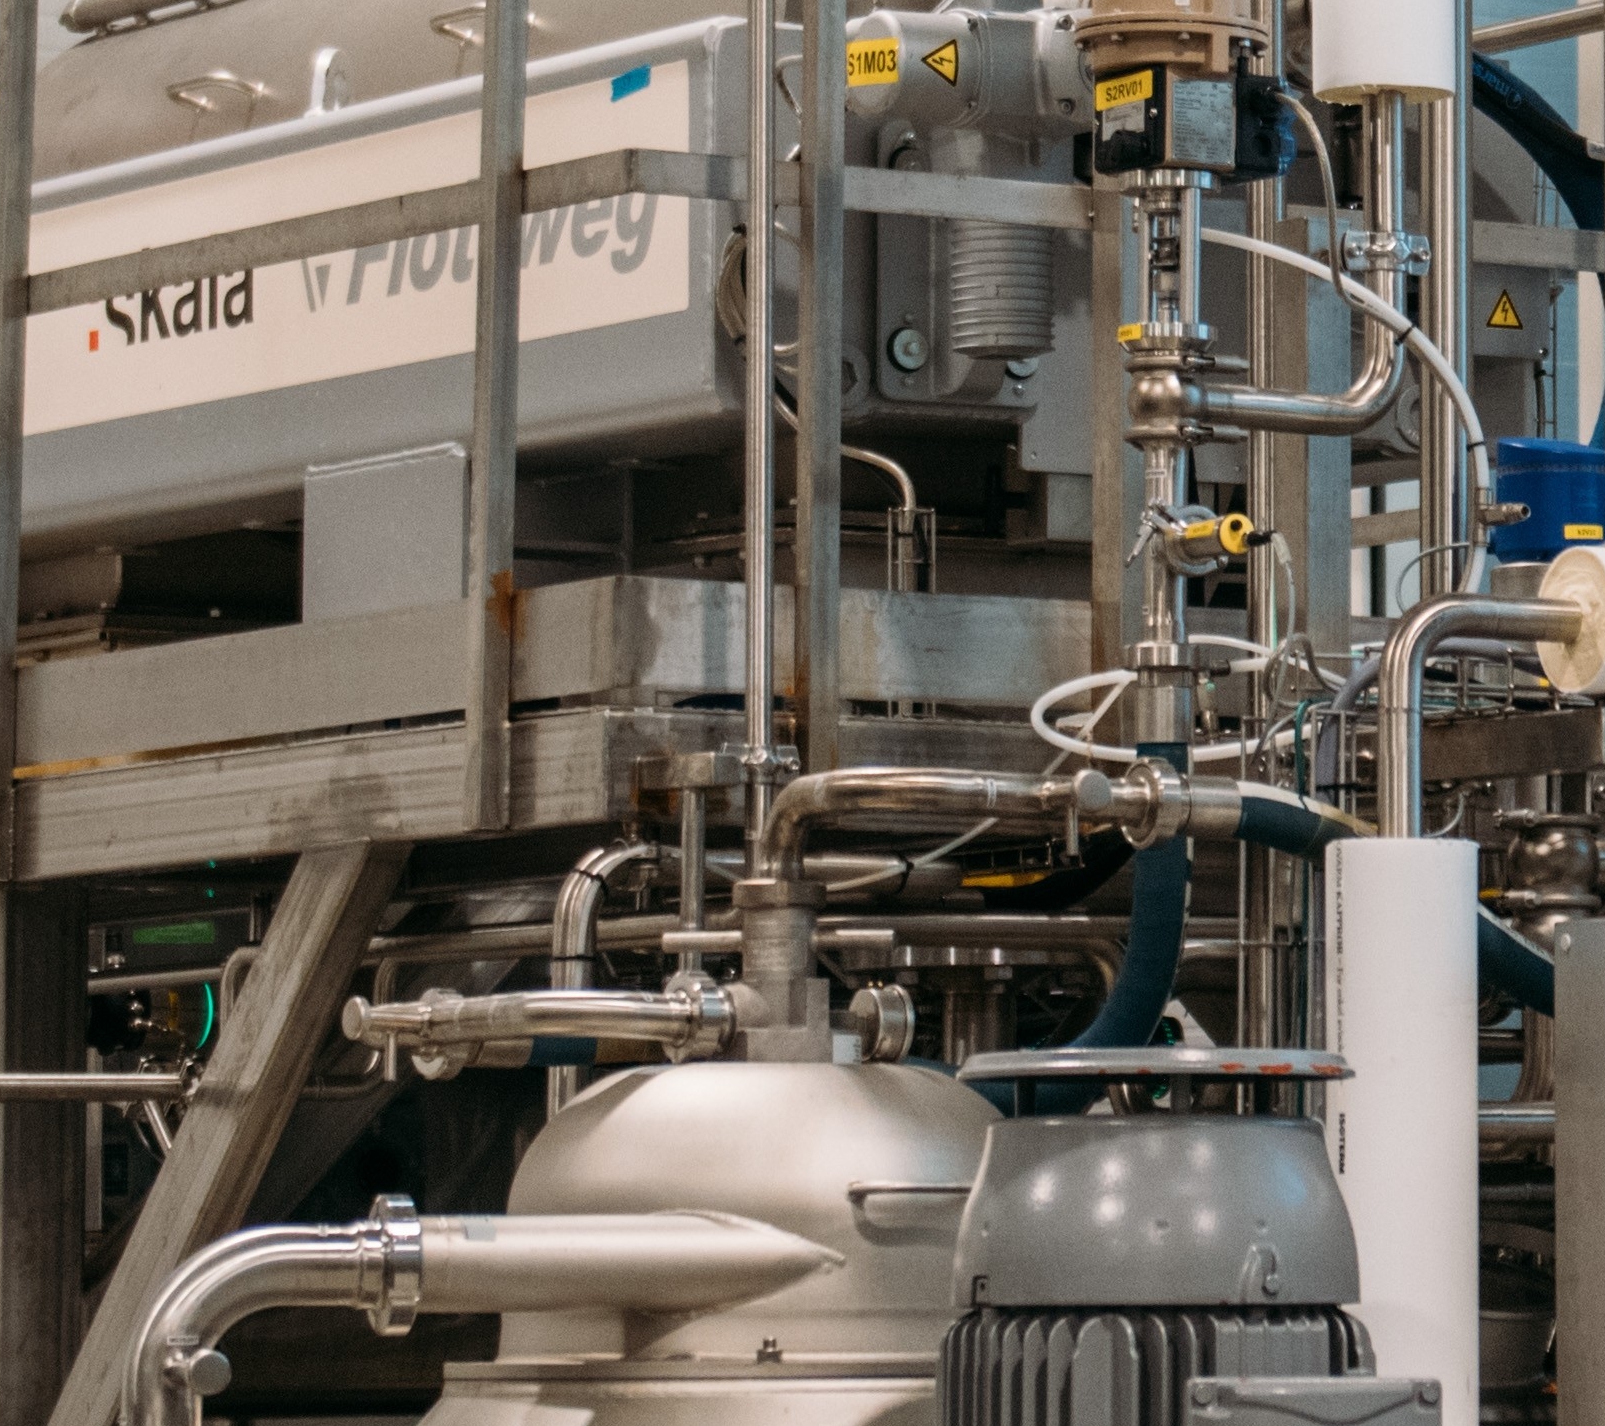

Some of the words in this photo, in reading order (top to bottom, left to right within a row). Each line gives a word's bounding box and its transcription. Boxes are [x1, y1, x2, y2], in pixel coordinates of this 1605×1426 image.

[848, 49, 897, 76] S1M03
[1105, 79, 1143, 102] S2RV01
[1338, 1112, 1346, 1175] ISOTERM
